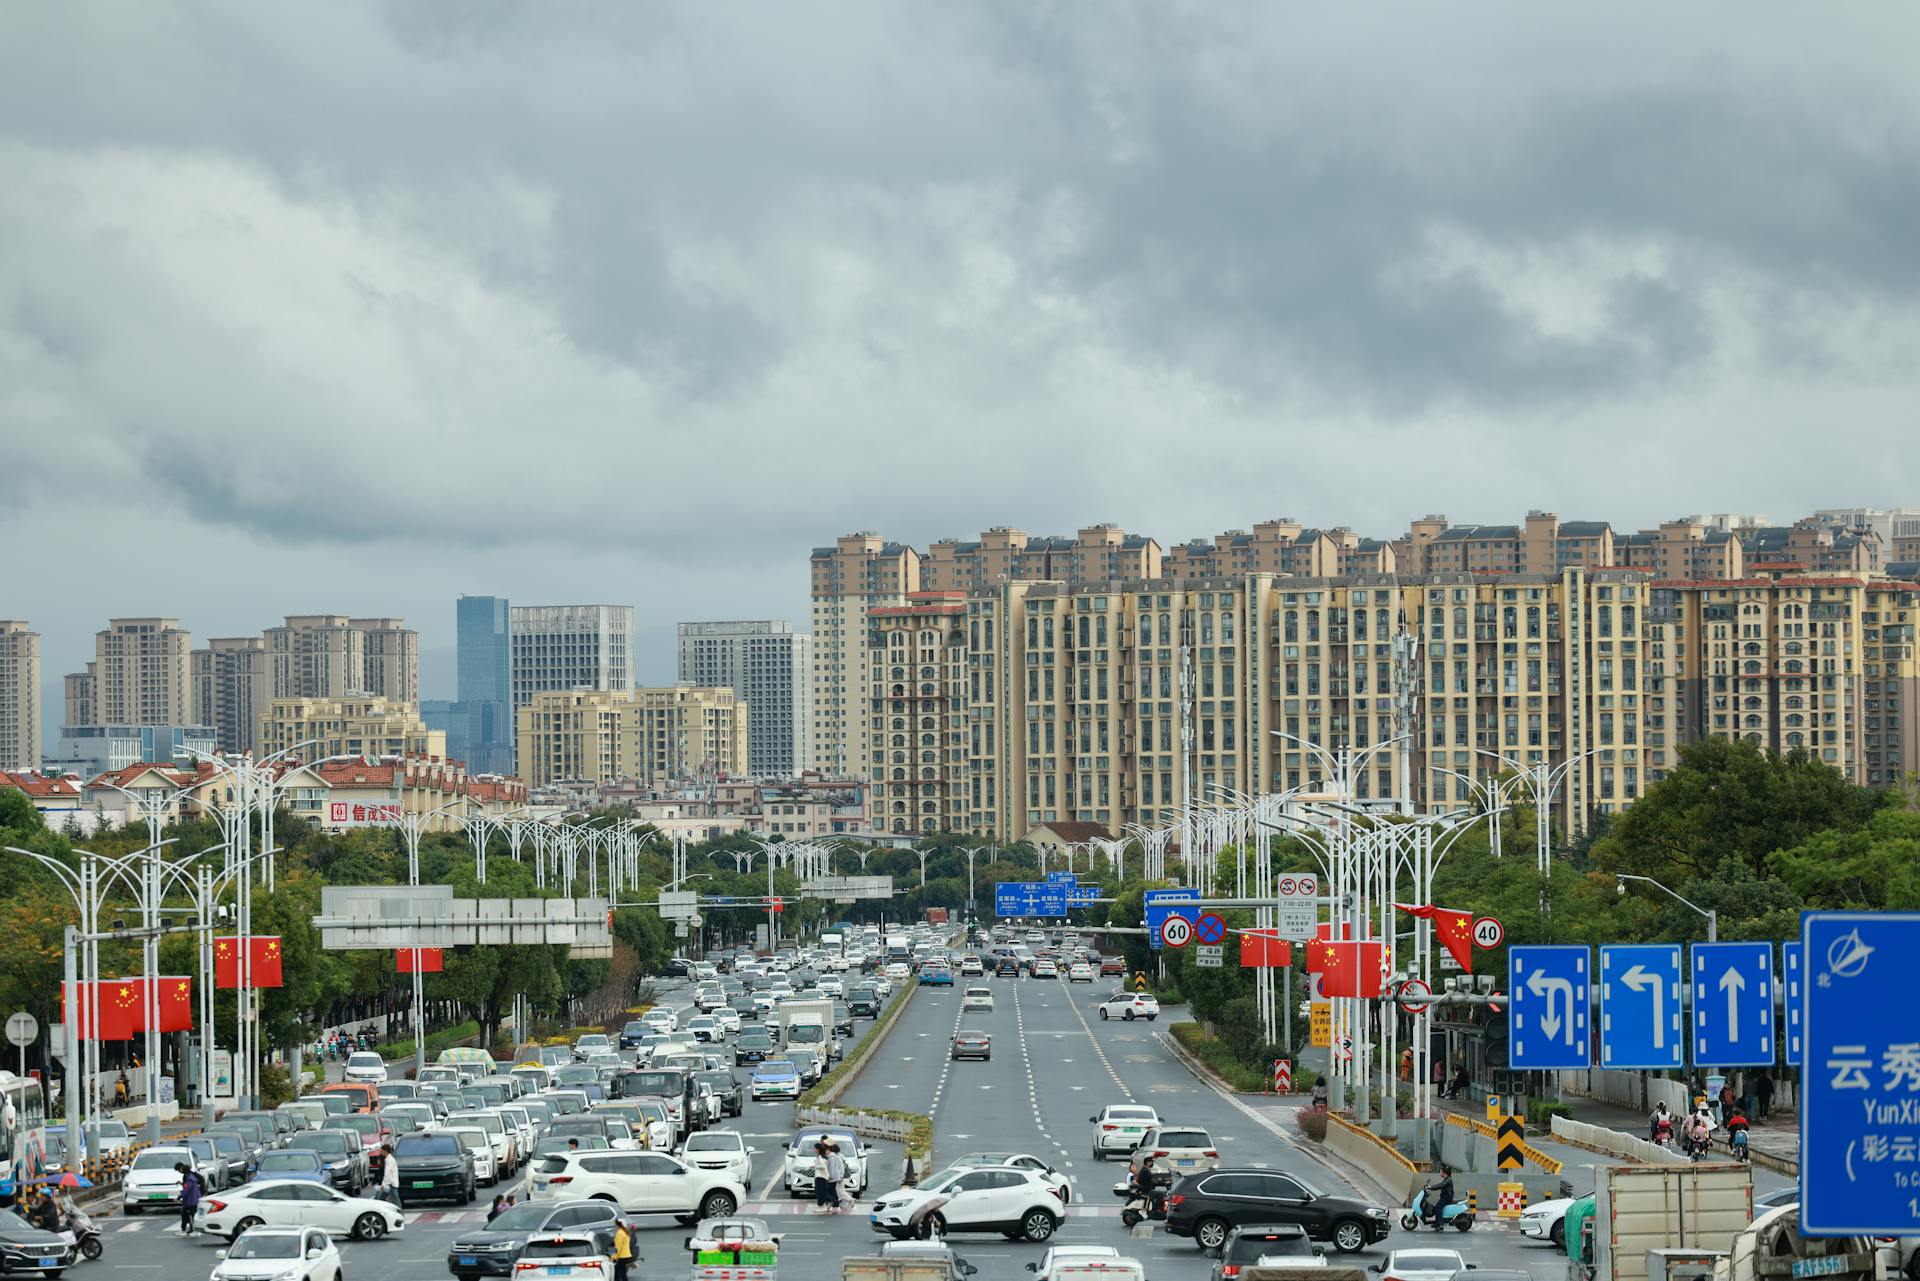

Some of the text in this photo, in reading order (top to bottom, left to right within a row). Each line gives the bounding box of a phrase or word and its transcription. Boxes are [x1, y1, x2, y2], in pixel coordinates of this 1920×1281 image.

[1168, 925, 1186, 939] 60
[1478, 926, 1497, 940] 40
[1826, 1042, 1920, 1092] 云秀
[1863, 1098, 1920, 1125] YunXi
[1894, 1170, 1920, 1188] To C
